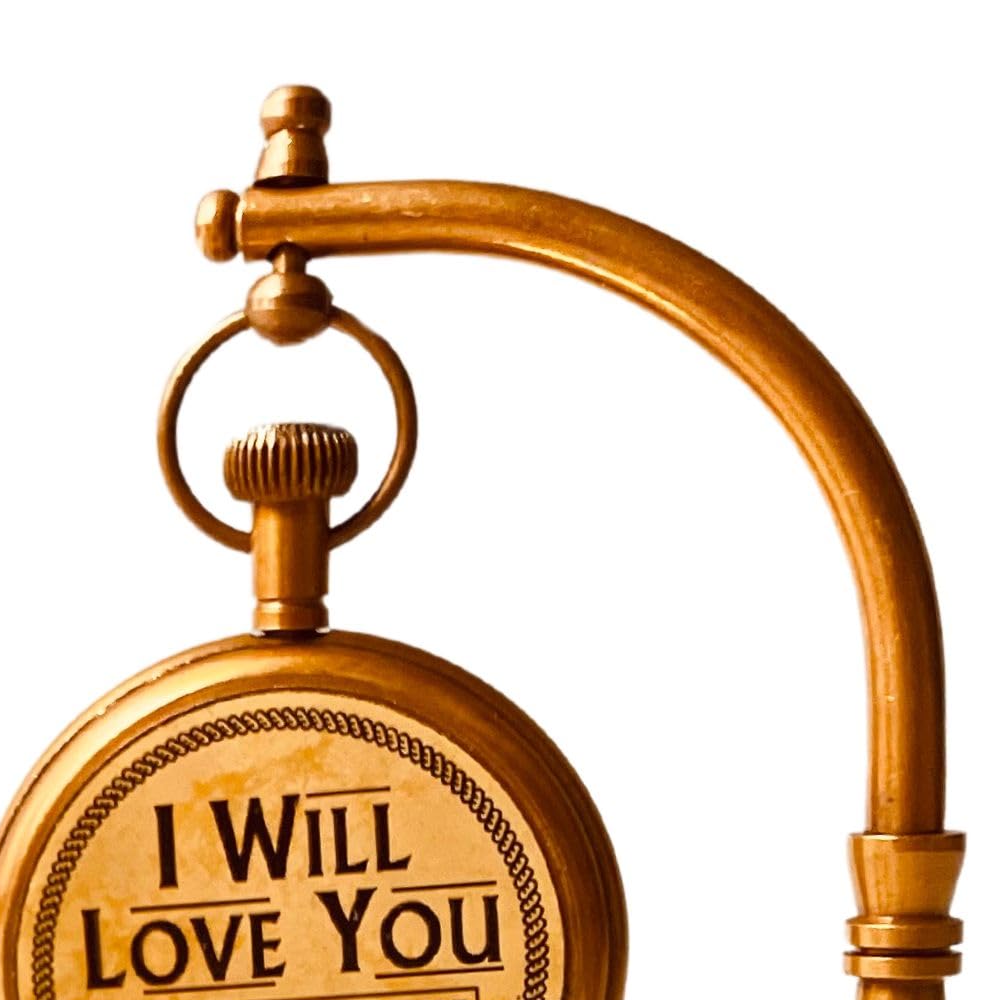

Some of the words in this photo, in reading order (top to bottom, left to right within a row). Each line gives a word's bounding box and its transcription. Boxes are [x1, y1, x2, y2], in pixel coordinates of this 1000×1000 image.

[154, 804, 180, 889] I
[209, 794, 412, 883] WILL
[81, 907, 287, 991] LOVE
[314, 887, 504, 973] YOU
